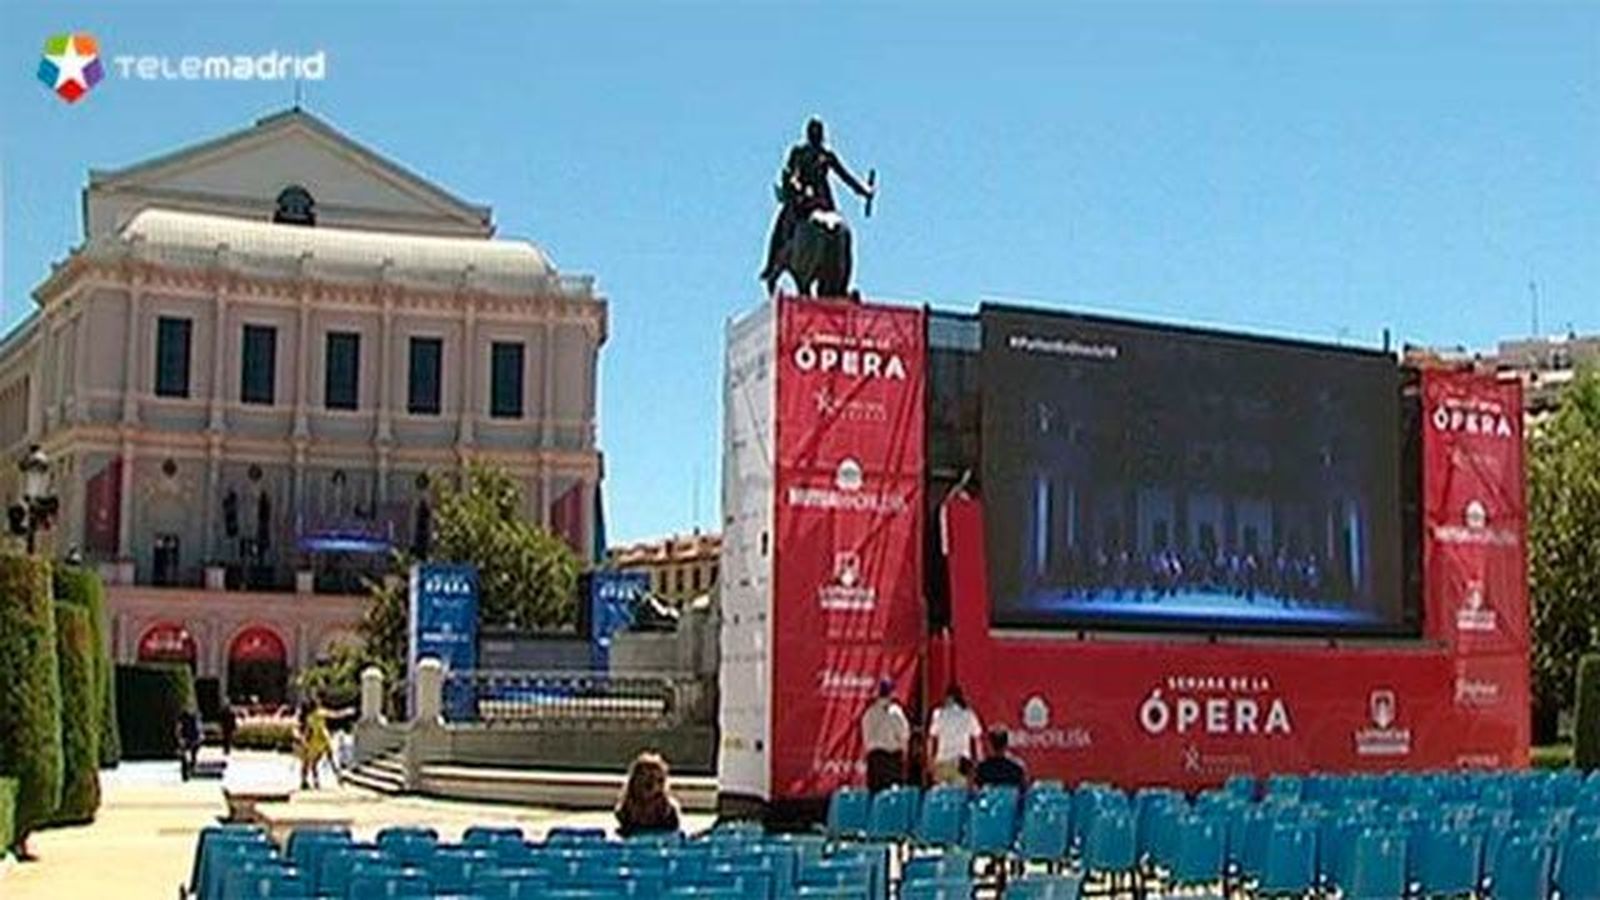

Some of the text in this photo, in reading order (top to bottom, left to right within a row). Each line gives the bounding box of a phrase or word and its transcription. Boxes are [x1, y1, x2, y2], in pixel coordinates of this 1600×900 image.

[795, 340, 906, 380] ÓPERA
[1433, 406, 1511, 437] ÓPERA
[1141, 688, 1292, 734] ÓPERA
